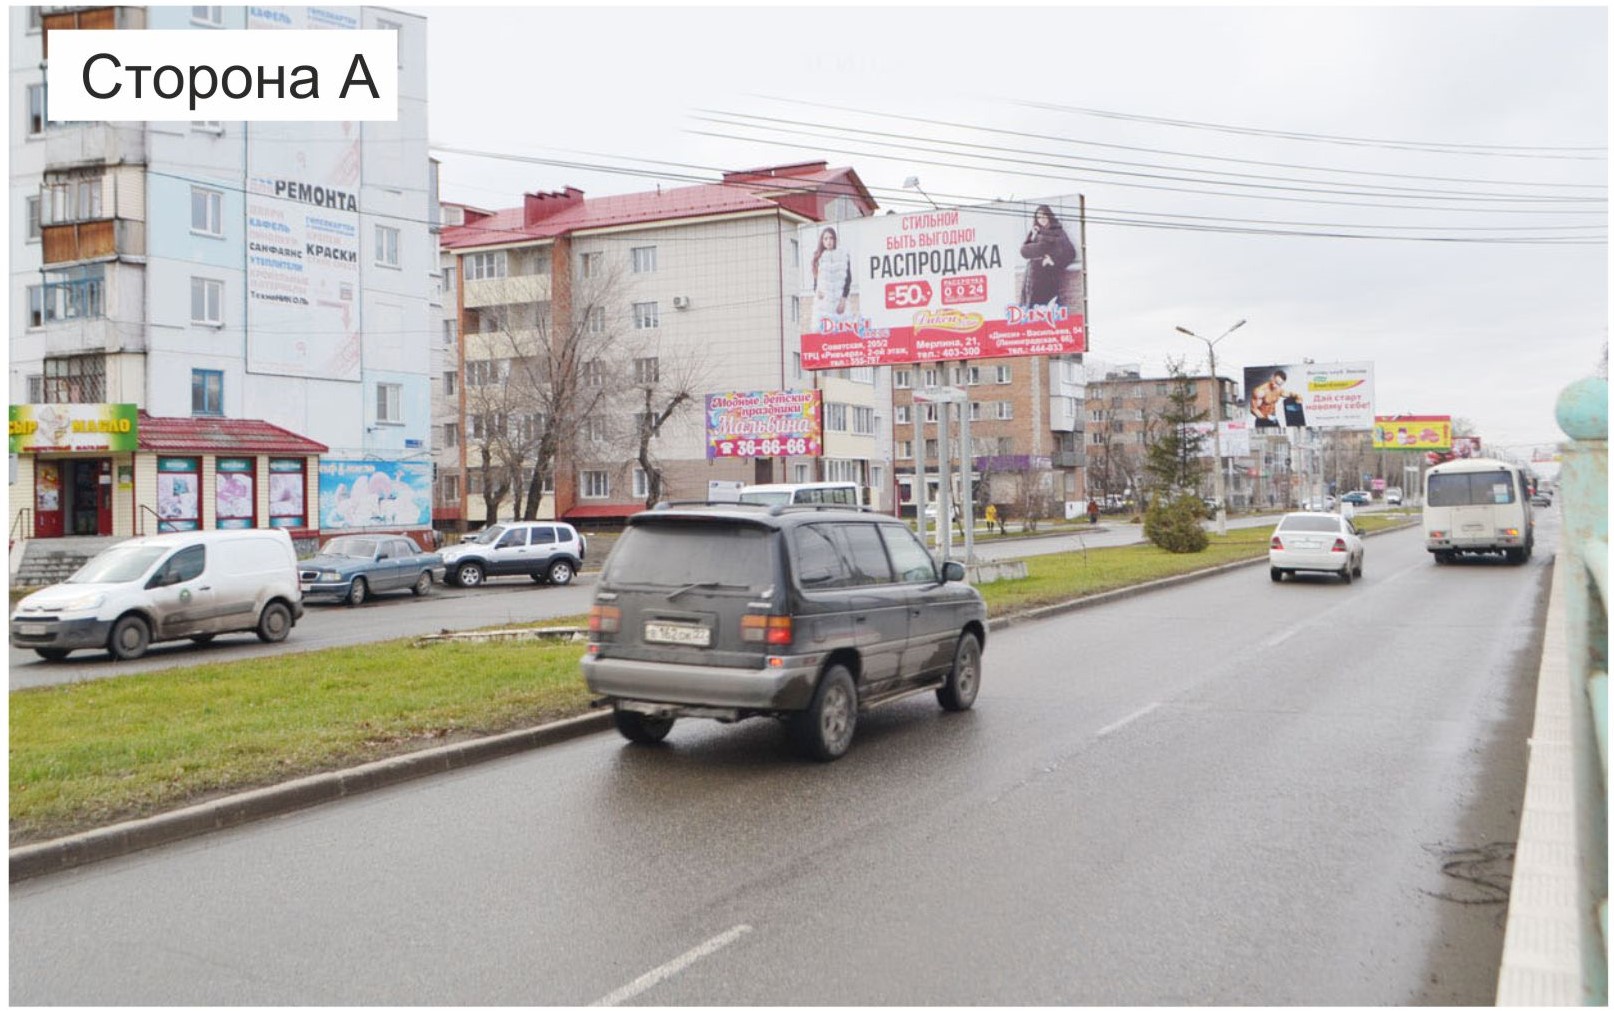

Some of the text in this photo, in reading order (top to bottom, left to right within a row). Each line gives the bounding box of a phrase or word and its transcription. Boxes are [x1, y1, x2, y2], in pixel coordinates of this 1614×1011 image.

[275, 180, 357, 212] РЕМОНТА
[902, 211, 958, 231] СТИЛЬНОЙ
[886, 228, 975, 250] БЫТЬ ВЫГОДНО!
[249, 242, 302, 259] САНФАЯНС
[306, 243, 357, 263] КРАСКИ
[870, 244, 1002, 279] РАСПРОДАЖА
[711, 393, 813, 409] Модные детские
[743, 404, 802, 417] праздники
[72, 418, 131, 434] МАСЛО
[715, 416, 810, 436] Мальвина
[736, 439, 806, 456] 36-66-66
